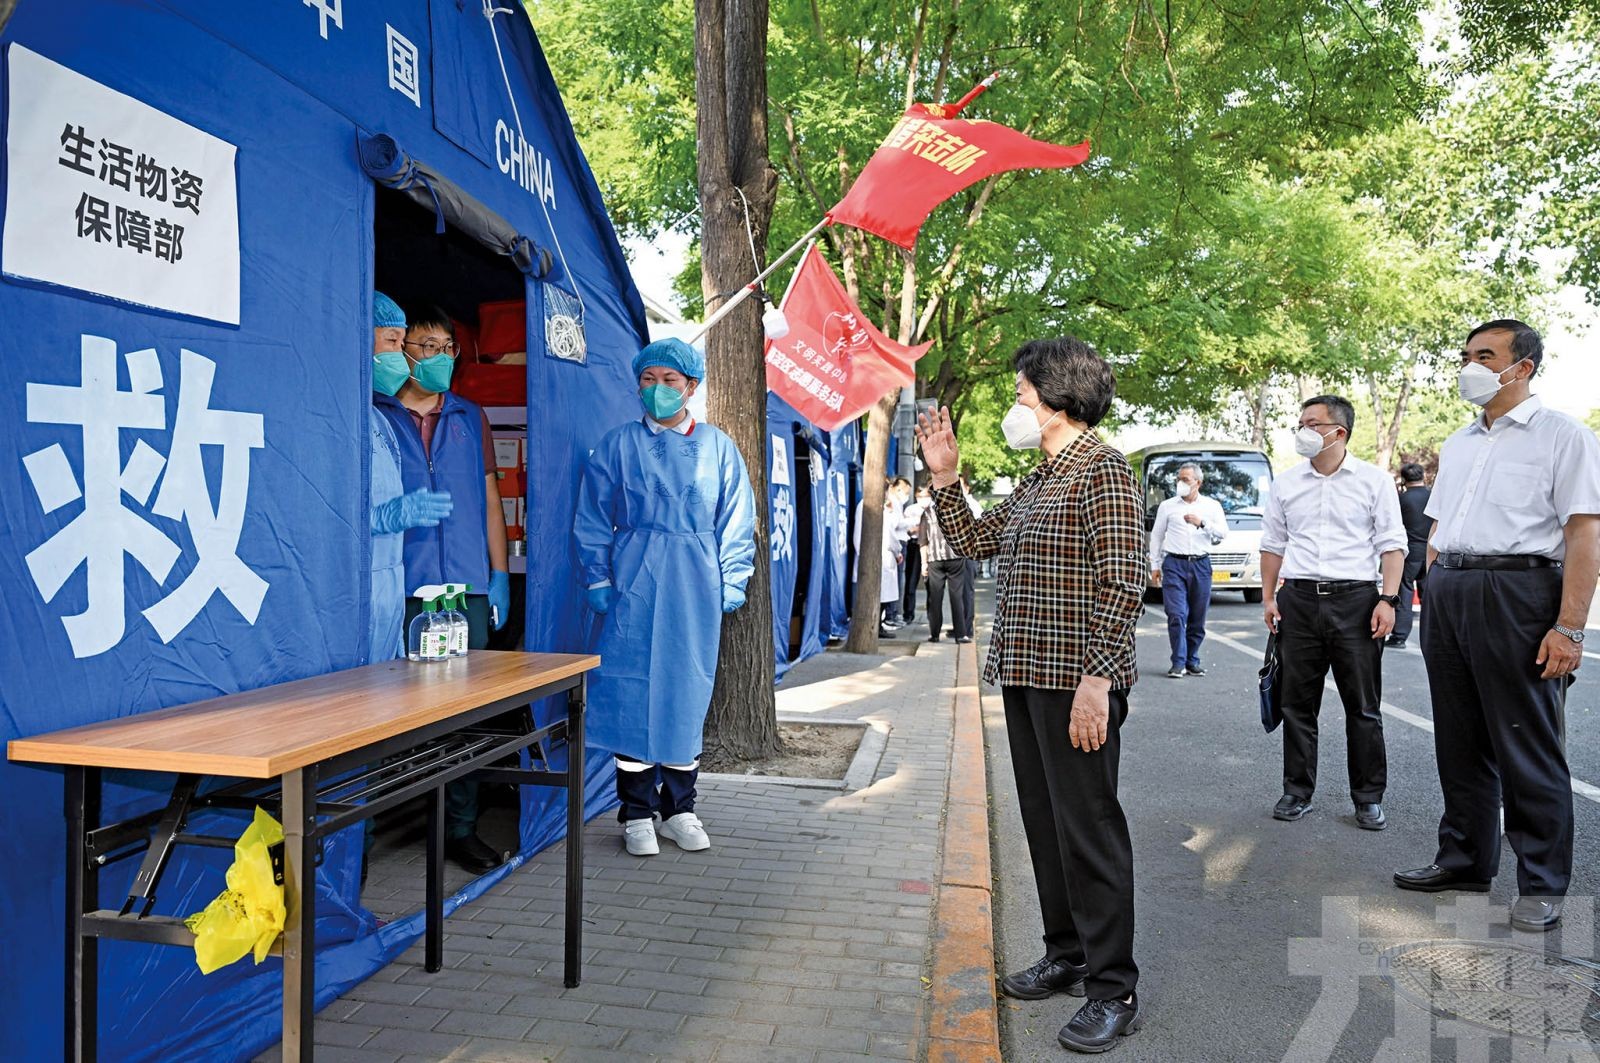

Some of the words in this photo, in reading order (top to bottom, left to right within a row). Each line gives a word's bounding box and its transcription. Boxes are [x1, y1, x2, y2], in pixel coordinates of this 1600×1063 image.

[58, 123, 203, 215] 生活物资
[495, 119, 556, 210] CHINA
[75, 192, 184, 264] 保障部
[22, 334, 270, 658] 救
